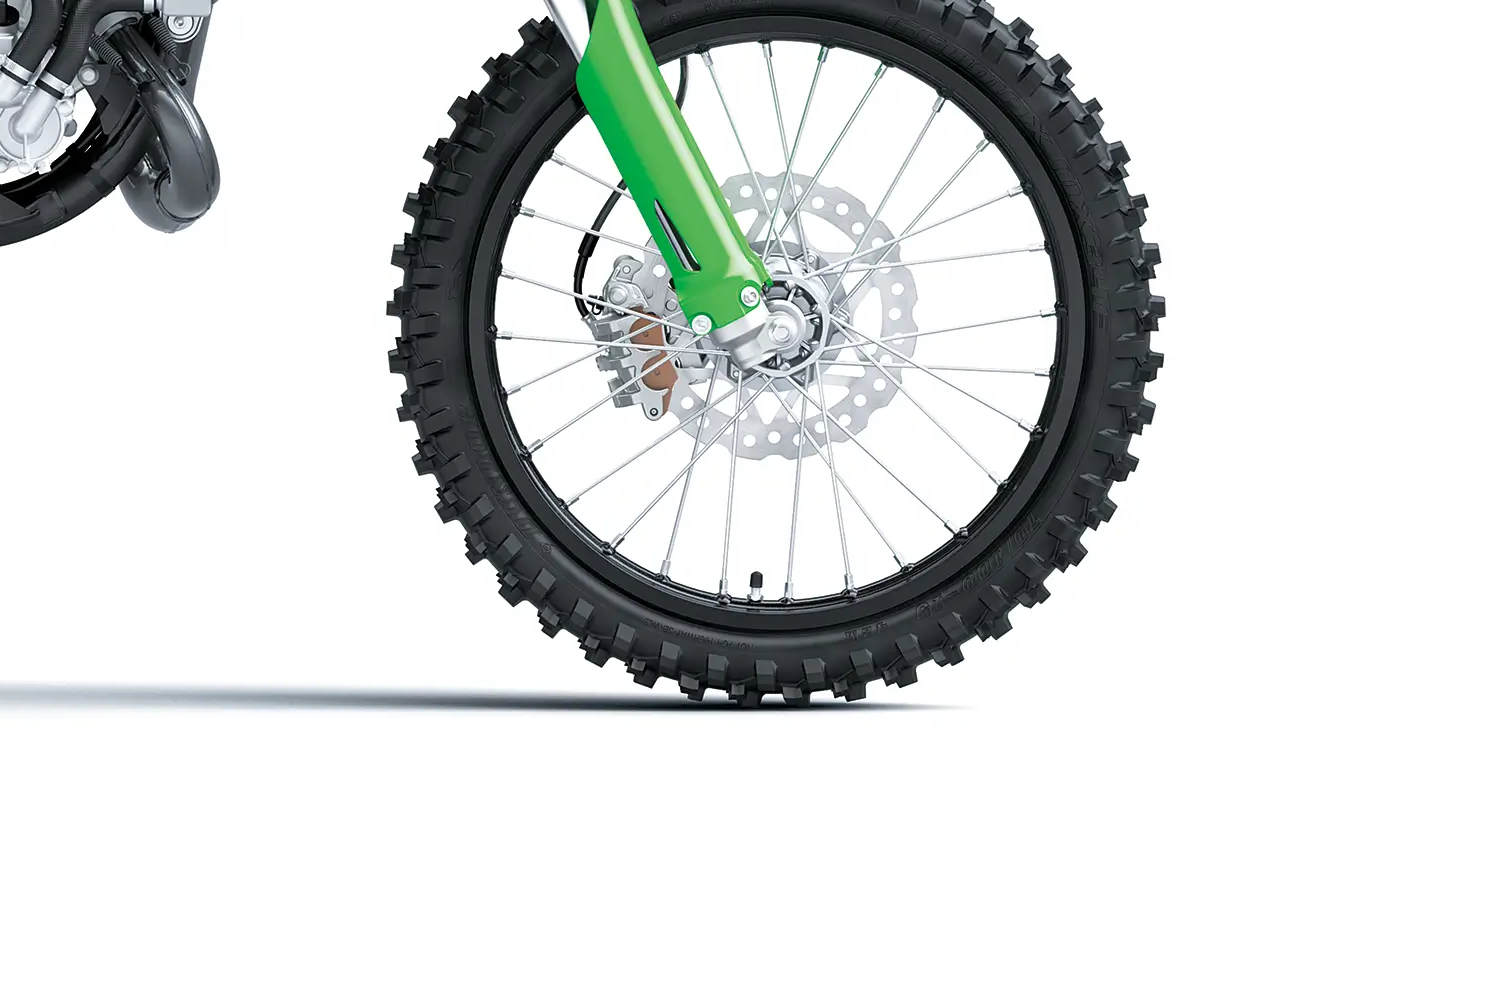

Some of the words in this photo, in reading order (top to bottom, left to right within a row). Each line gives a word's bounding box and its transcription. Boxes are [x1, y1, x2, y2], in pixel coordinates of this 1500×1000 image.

[642, 616, 674, 633] SERVICE
[676, 629, 714, 645] HIGHWAY
[714, 638, 732, 648] FOR
[736, 641, 754, 651] NOT
